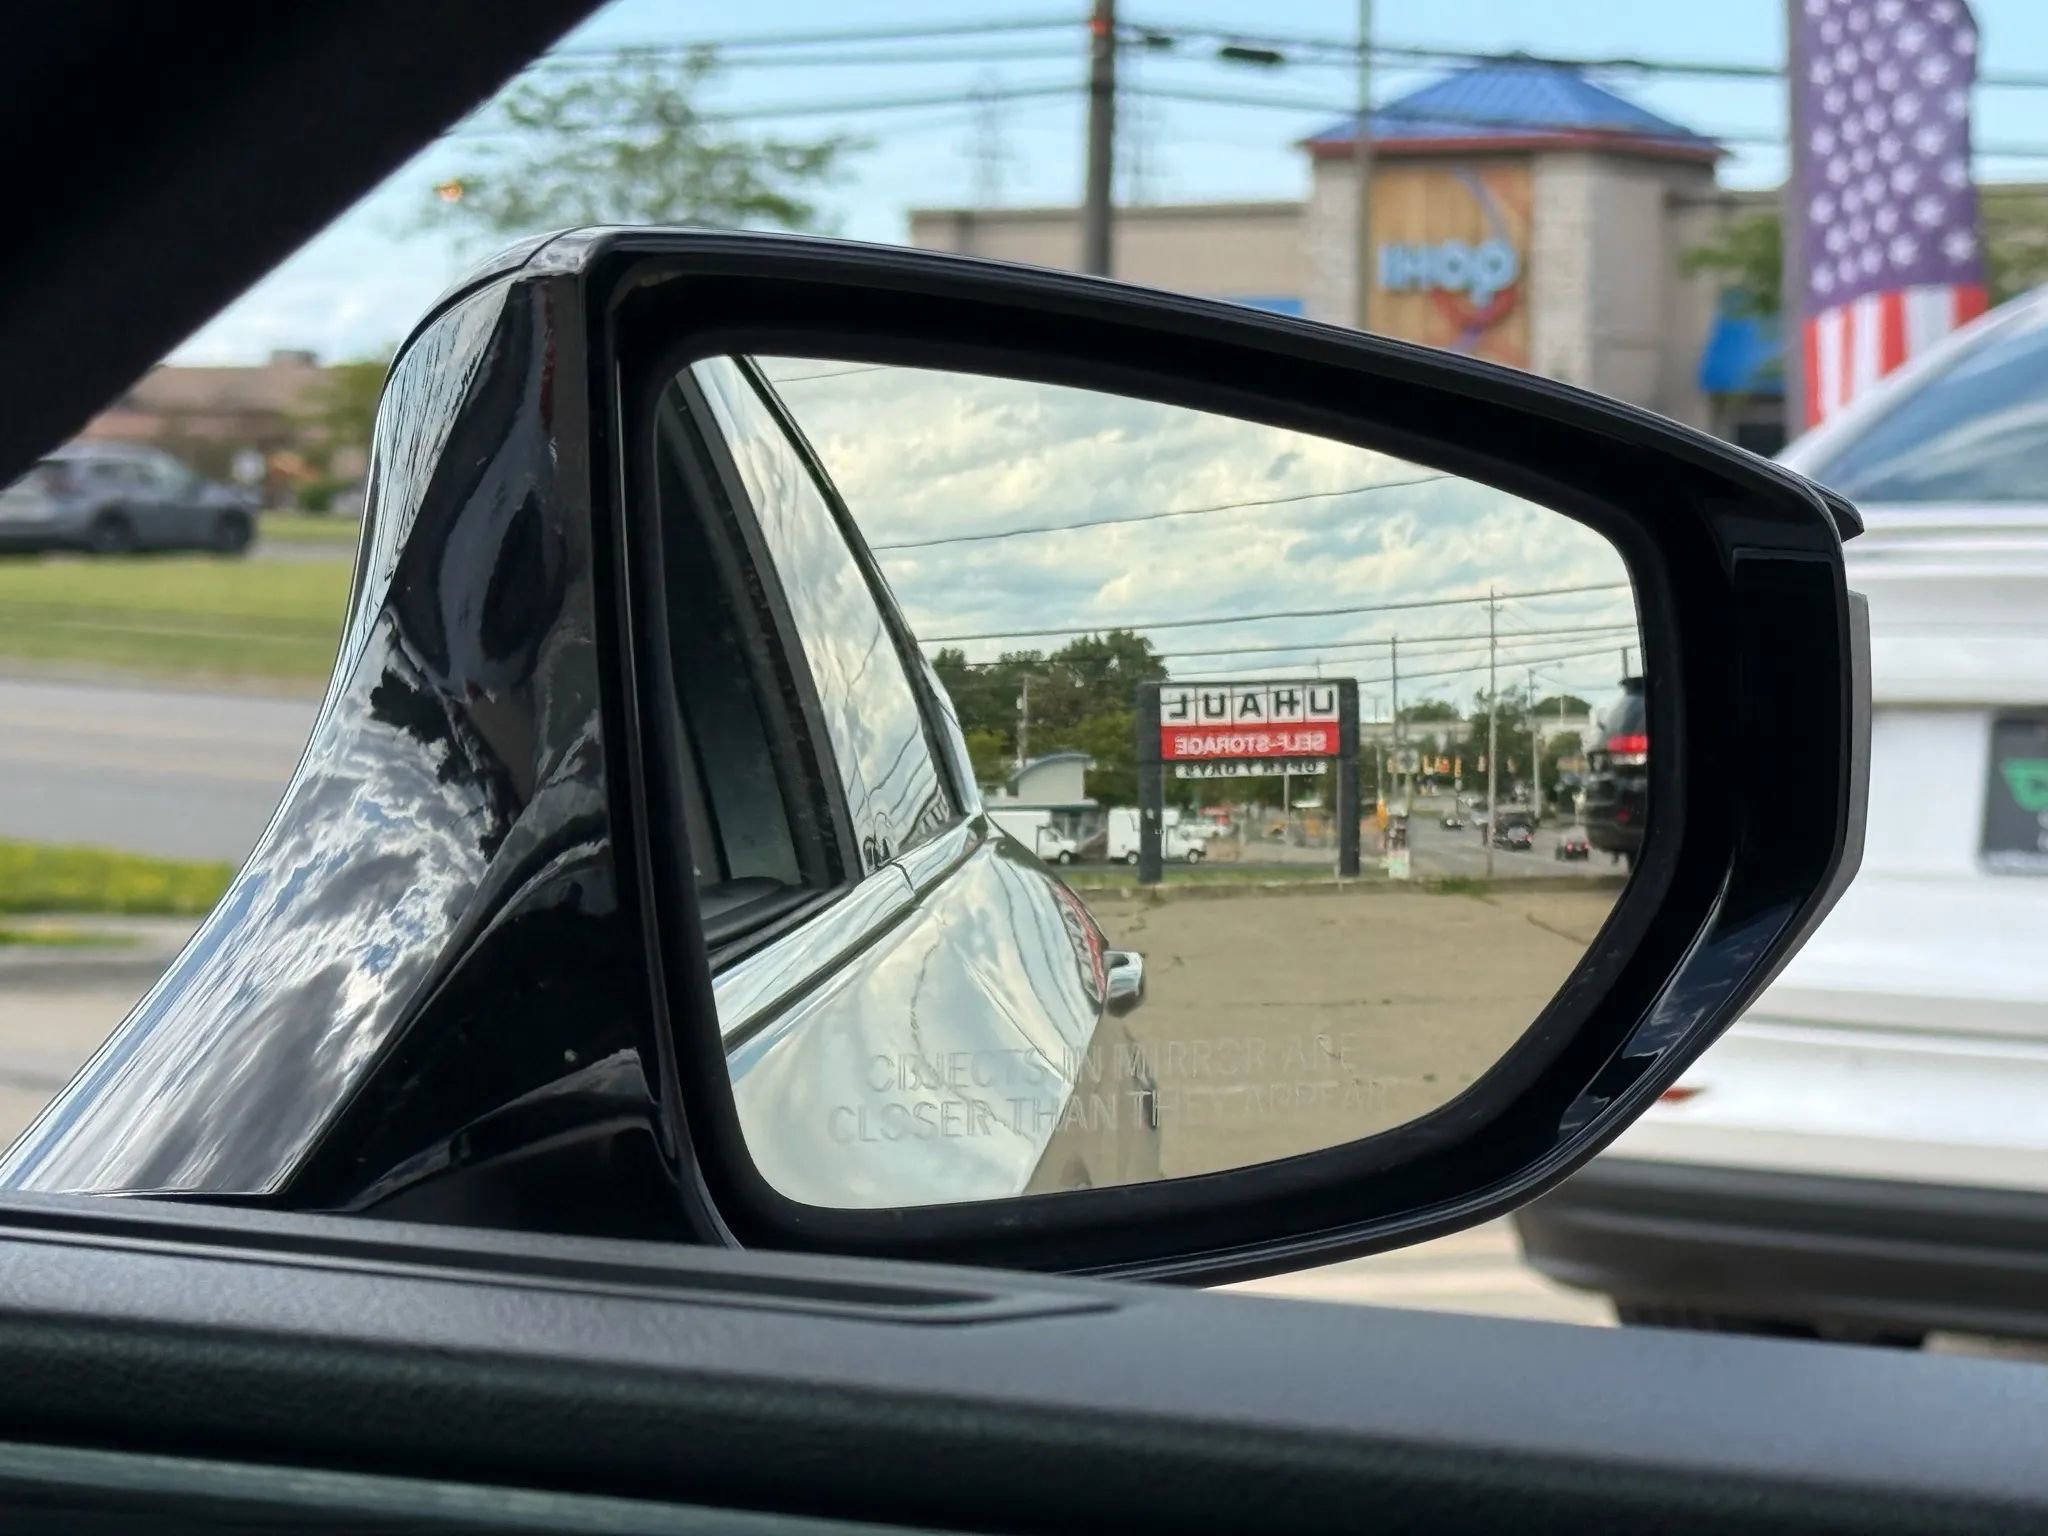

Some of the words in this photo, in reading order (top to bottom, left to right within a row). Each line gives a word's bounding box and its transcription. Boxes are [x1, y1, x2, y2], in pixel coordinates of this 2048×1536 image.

[867, 1047, 1047, 1092] OBJECTS
[1062, 1044, 1103, 1084] IN
[1112, 1037, 1267, 1081] MIRROR
[827, 1097, 994, 1144] CLOSER
[1005, 1093, 1118, 1136] THAN
